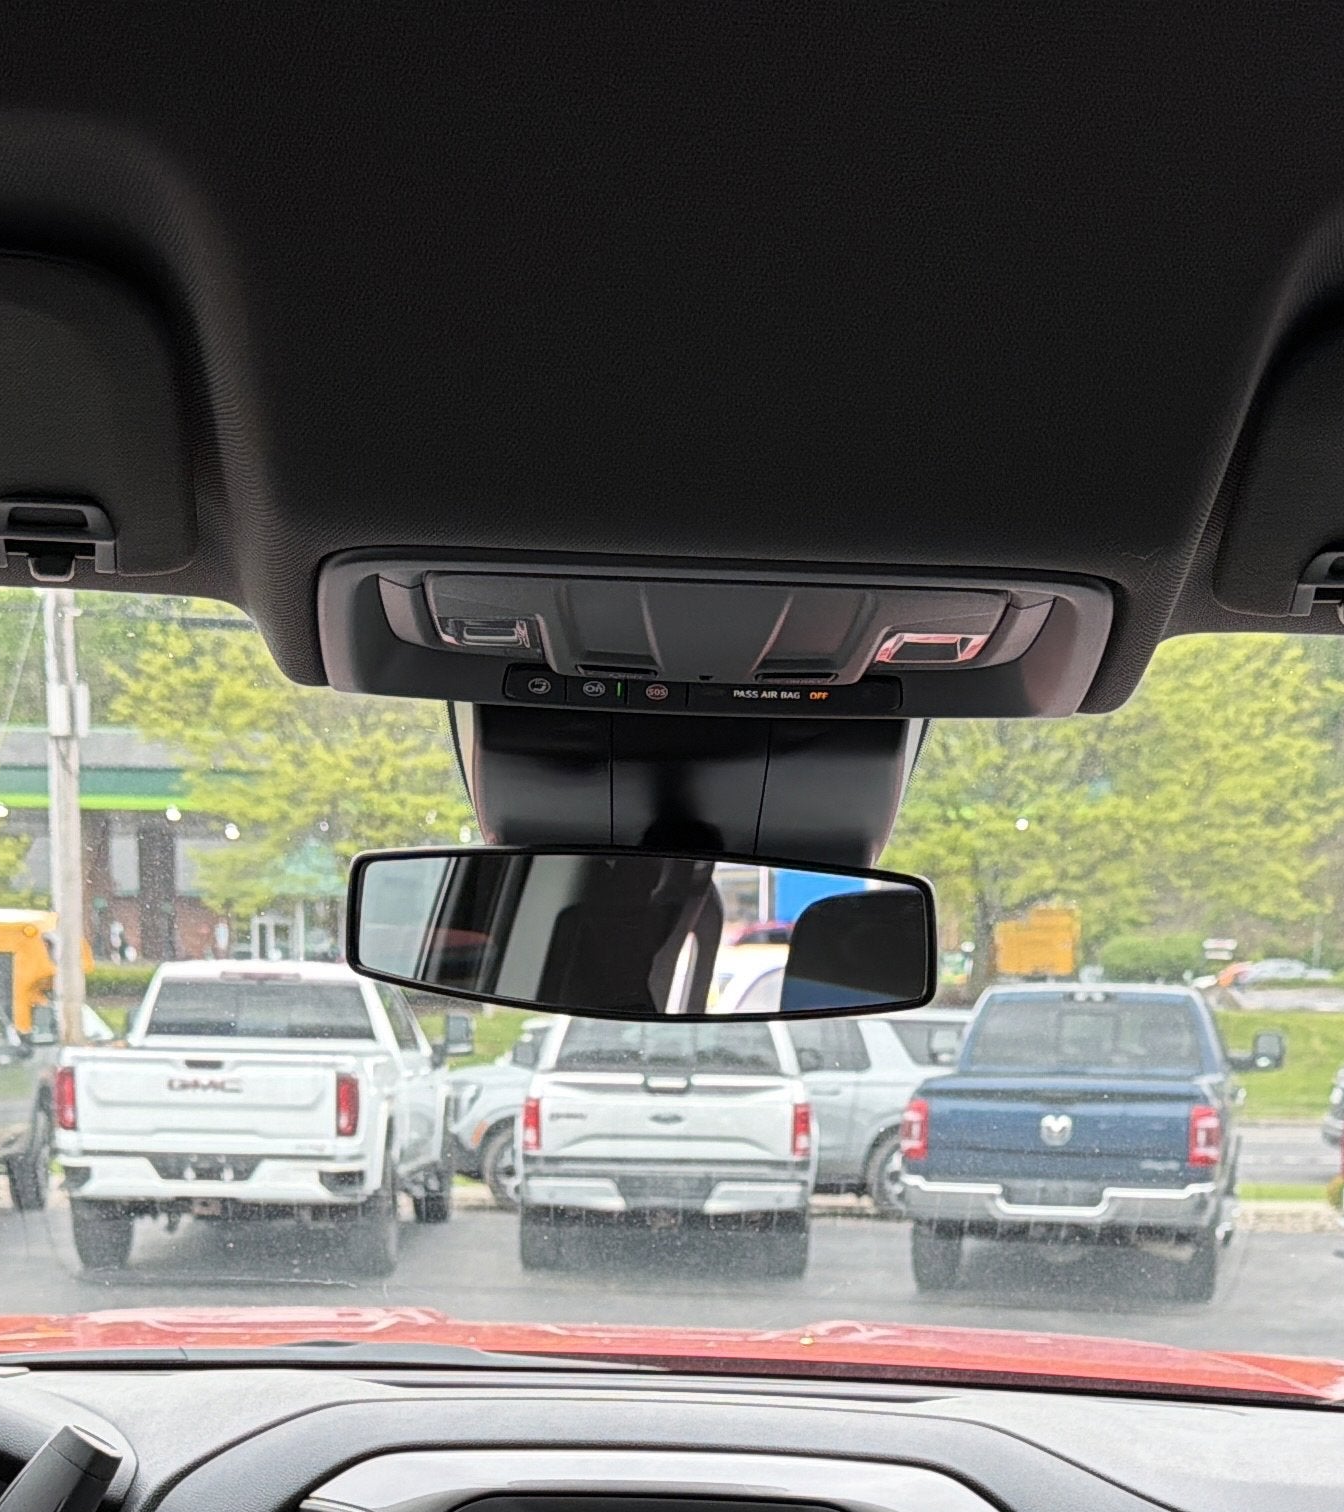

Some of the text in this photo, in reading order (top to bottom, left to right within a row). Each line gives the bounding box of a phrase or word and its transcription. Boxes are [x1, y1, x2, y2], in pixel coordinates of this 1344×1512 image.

[647, 687, 667, 697] SOS
[733, 690, 829, 700] PASS AIR BAG OFF
